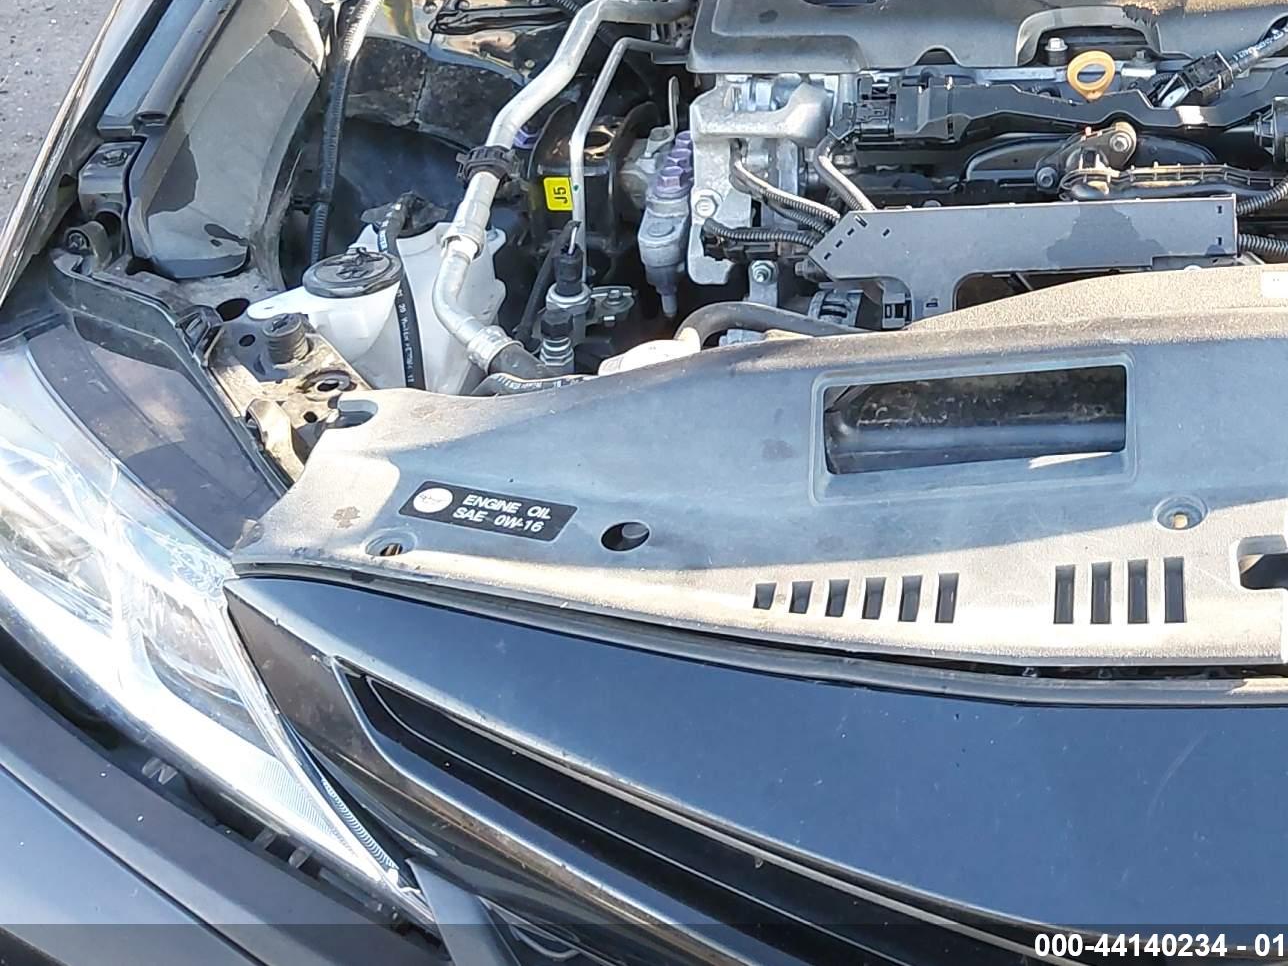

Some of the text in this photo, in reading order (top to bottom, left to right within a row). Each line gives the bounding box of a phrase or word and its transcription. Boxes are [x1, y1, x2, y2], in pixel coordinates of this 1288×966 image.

[553, 186, 568, 204] J5
[452, 507, 545, 532] SAE 0W-16
[462, 494, 552, 520] ENGINE OIL
